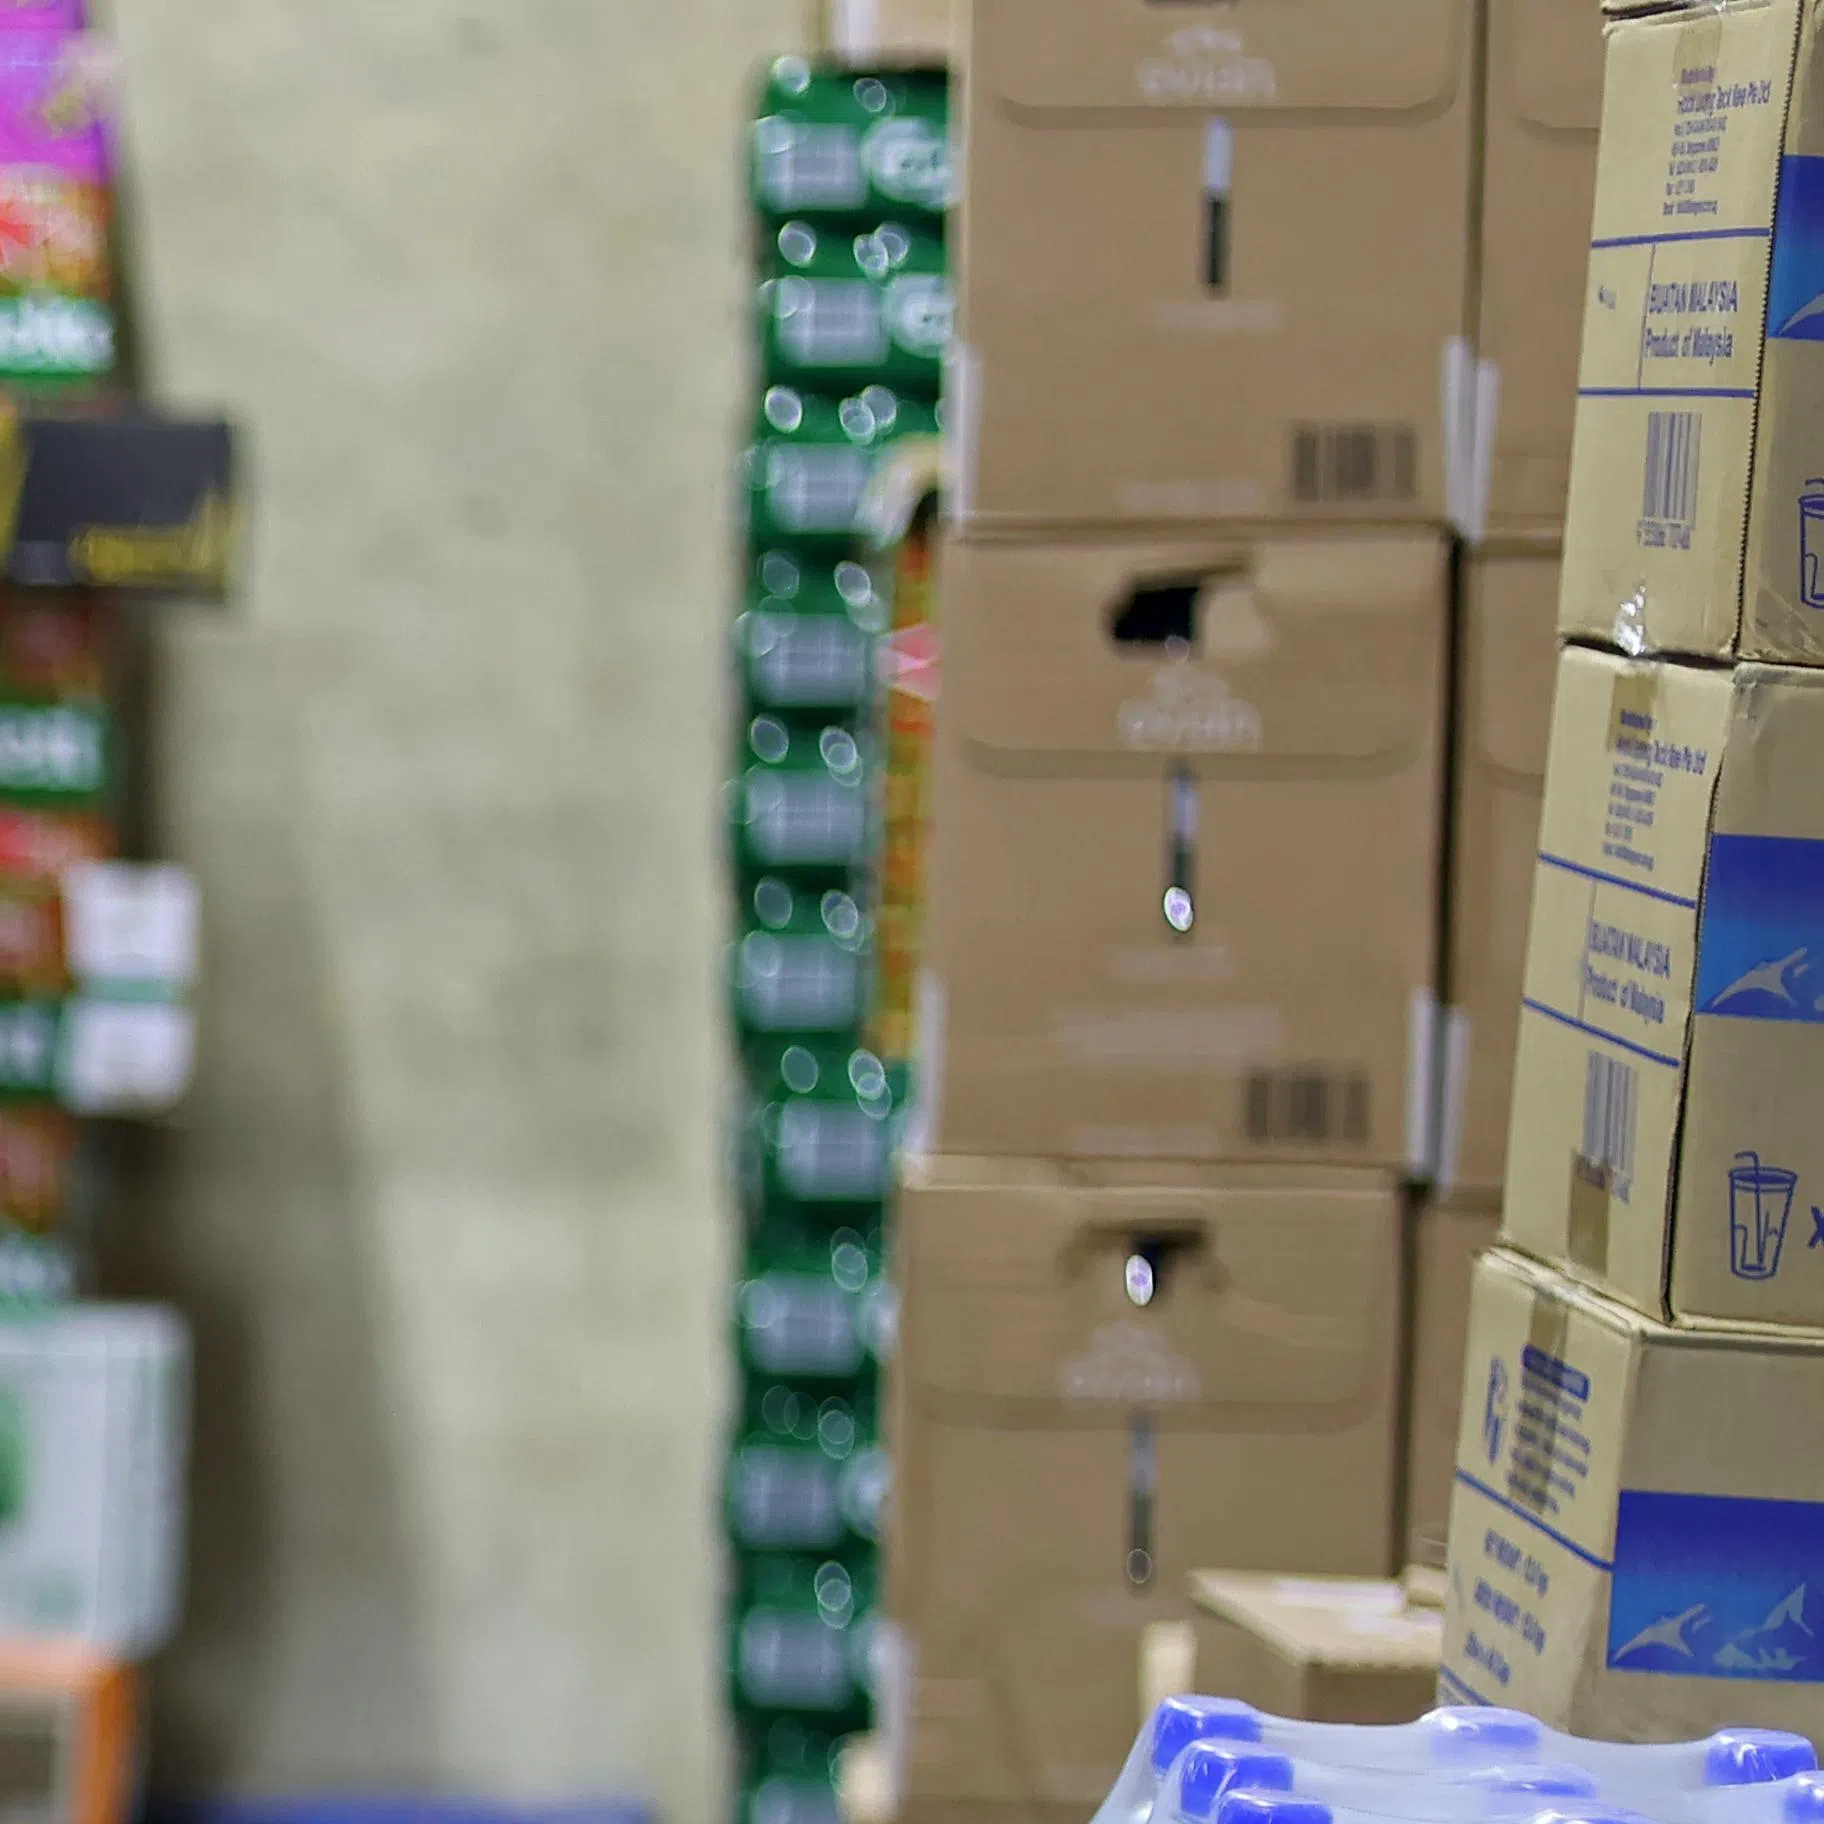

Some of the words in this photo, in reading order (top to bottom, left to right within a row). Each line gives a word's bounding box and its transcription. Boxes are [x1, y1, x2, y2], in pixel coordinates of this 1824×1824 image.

[1688, 280, 1738, 312] MALAYSIA
[1644, 327, 1680, 358] Product
[1692, 327, 1733, 366] Malaysia
[1627, 932, 1671, 980] MALAYSIA
